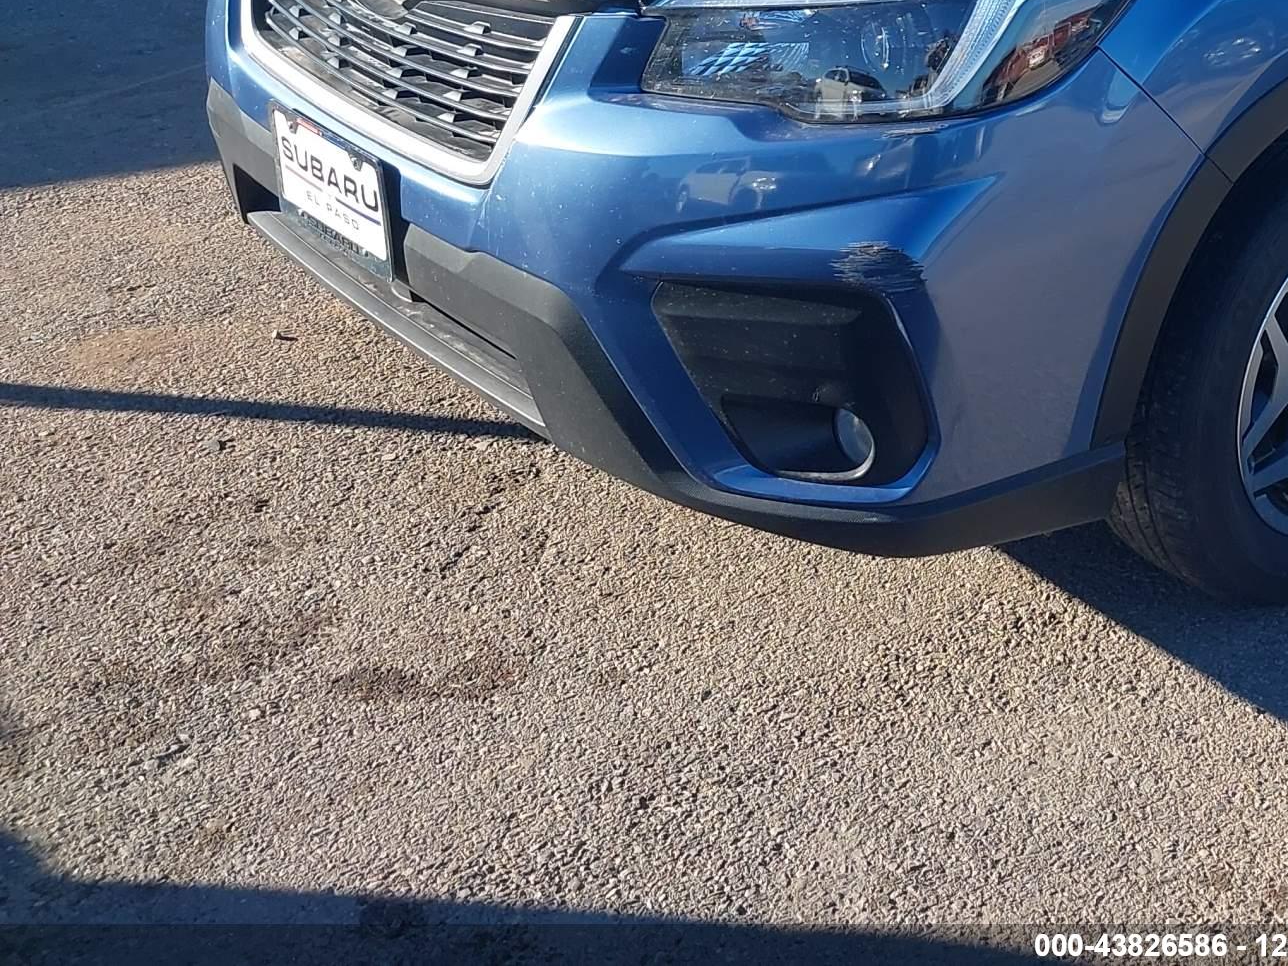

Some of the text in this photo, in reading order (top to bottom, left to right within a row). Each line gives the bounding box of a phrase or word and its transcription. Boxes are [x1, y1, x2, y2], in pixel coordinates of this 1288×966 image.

[280, 136, 380, 213] SUBARU
[306, 190, 361, 231] EL PASO
